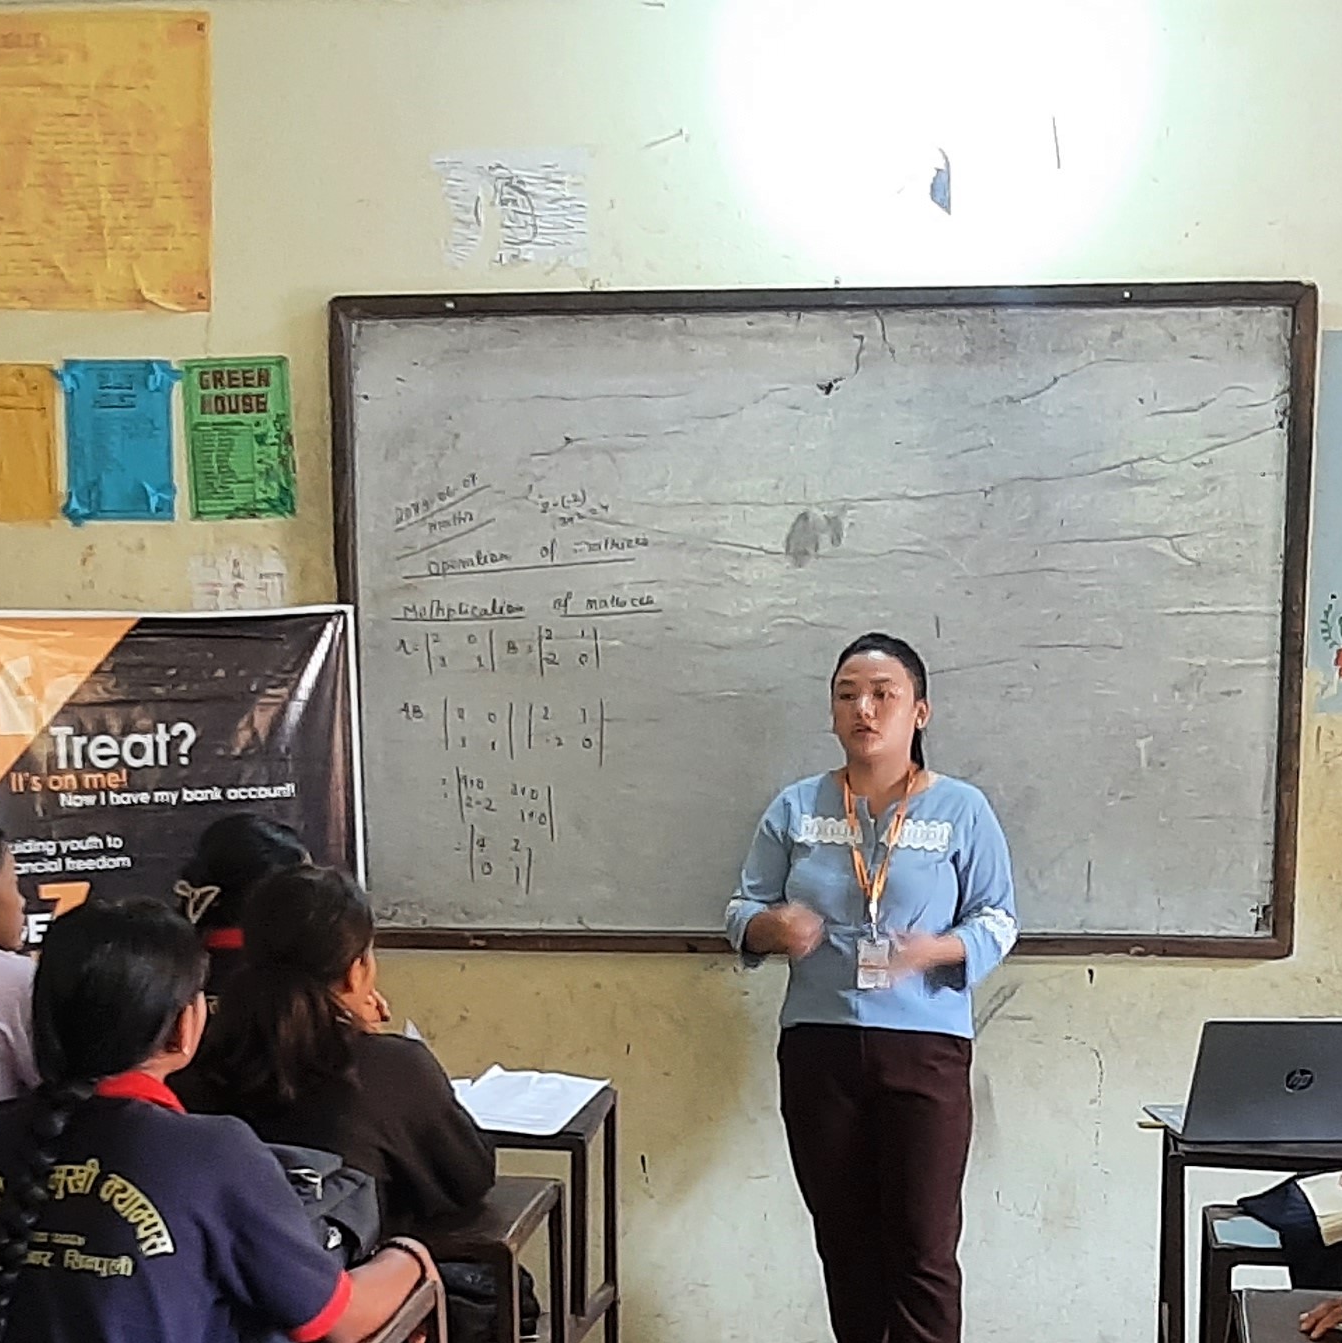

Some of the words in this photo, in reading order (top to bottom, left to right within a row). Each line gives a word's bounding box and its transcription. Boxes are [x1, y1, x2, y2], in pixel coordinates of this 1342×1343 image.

[199, 367, 271, 390] GREEN
[200, 393, 268, 415] HOUSE
[49, 721, 197, 771] Treat?
[9, 771, 42, 794] It's
[46, 774, 78, 792] on
[83, 768, 129, 790] me!
[59, 791, 97, 809] Now
[100, 789, 107, 806] I
[109, 788, 150, 806] have
[153, 789, 178, 807] my
[182, 785, 222, 802] bank
[226, 782, 297, 800] account!
[58, 836, 104, 854] youth
[106, 835, 123, 850] to
[64, 855, 132, 872] freedom
